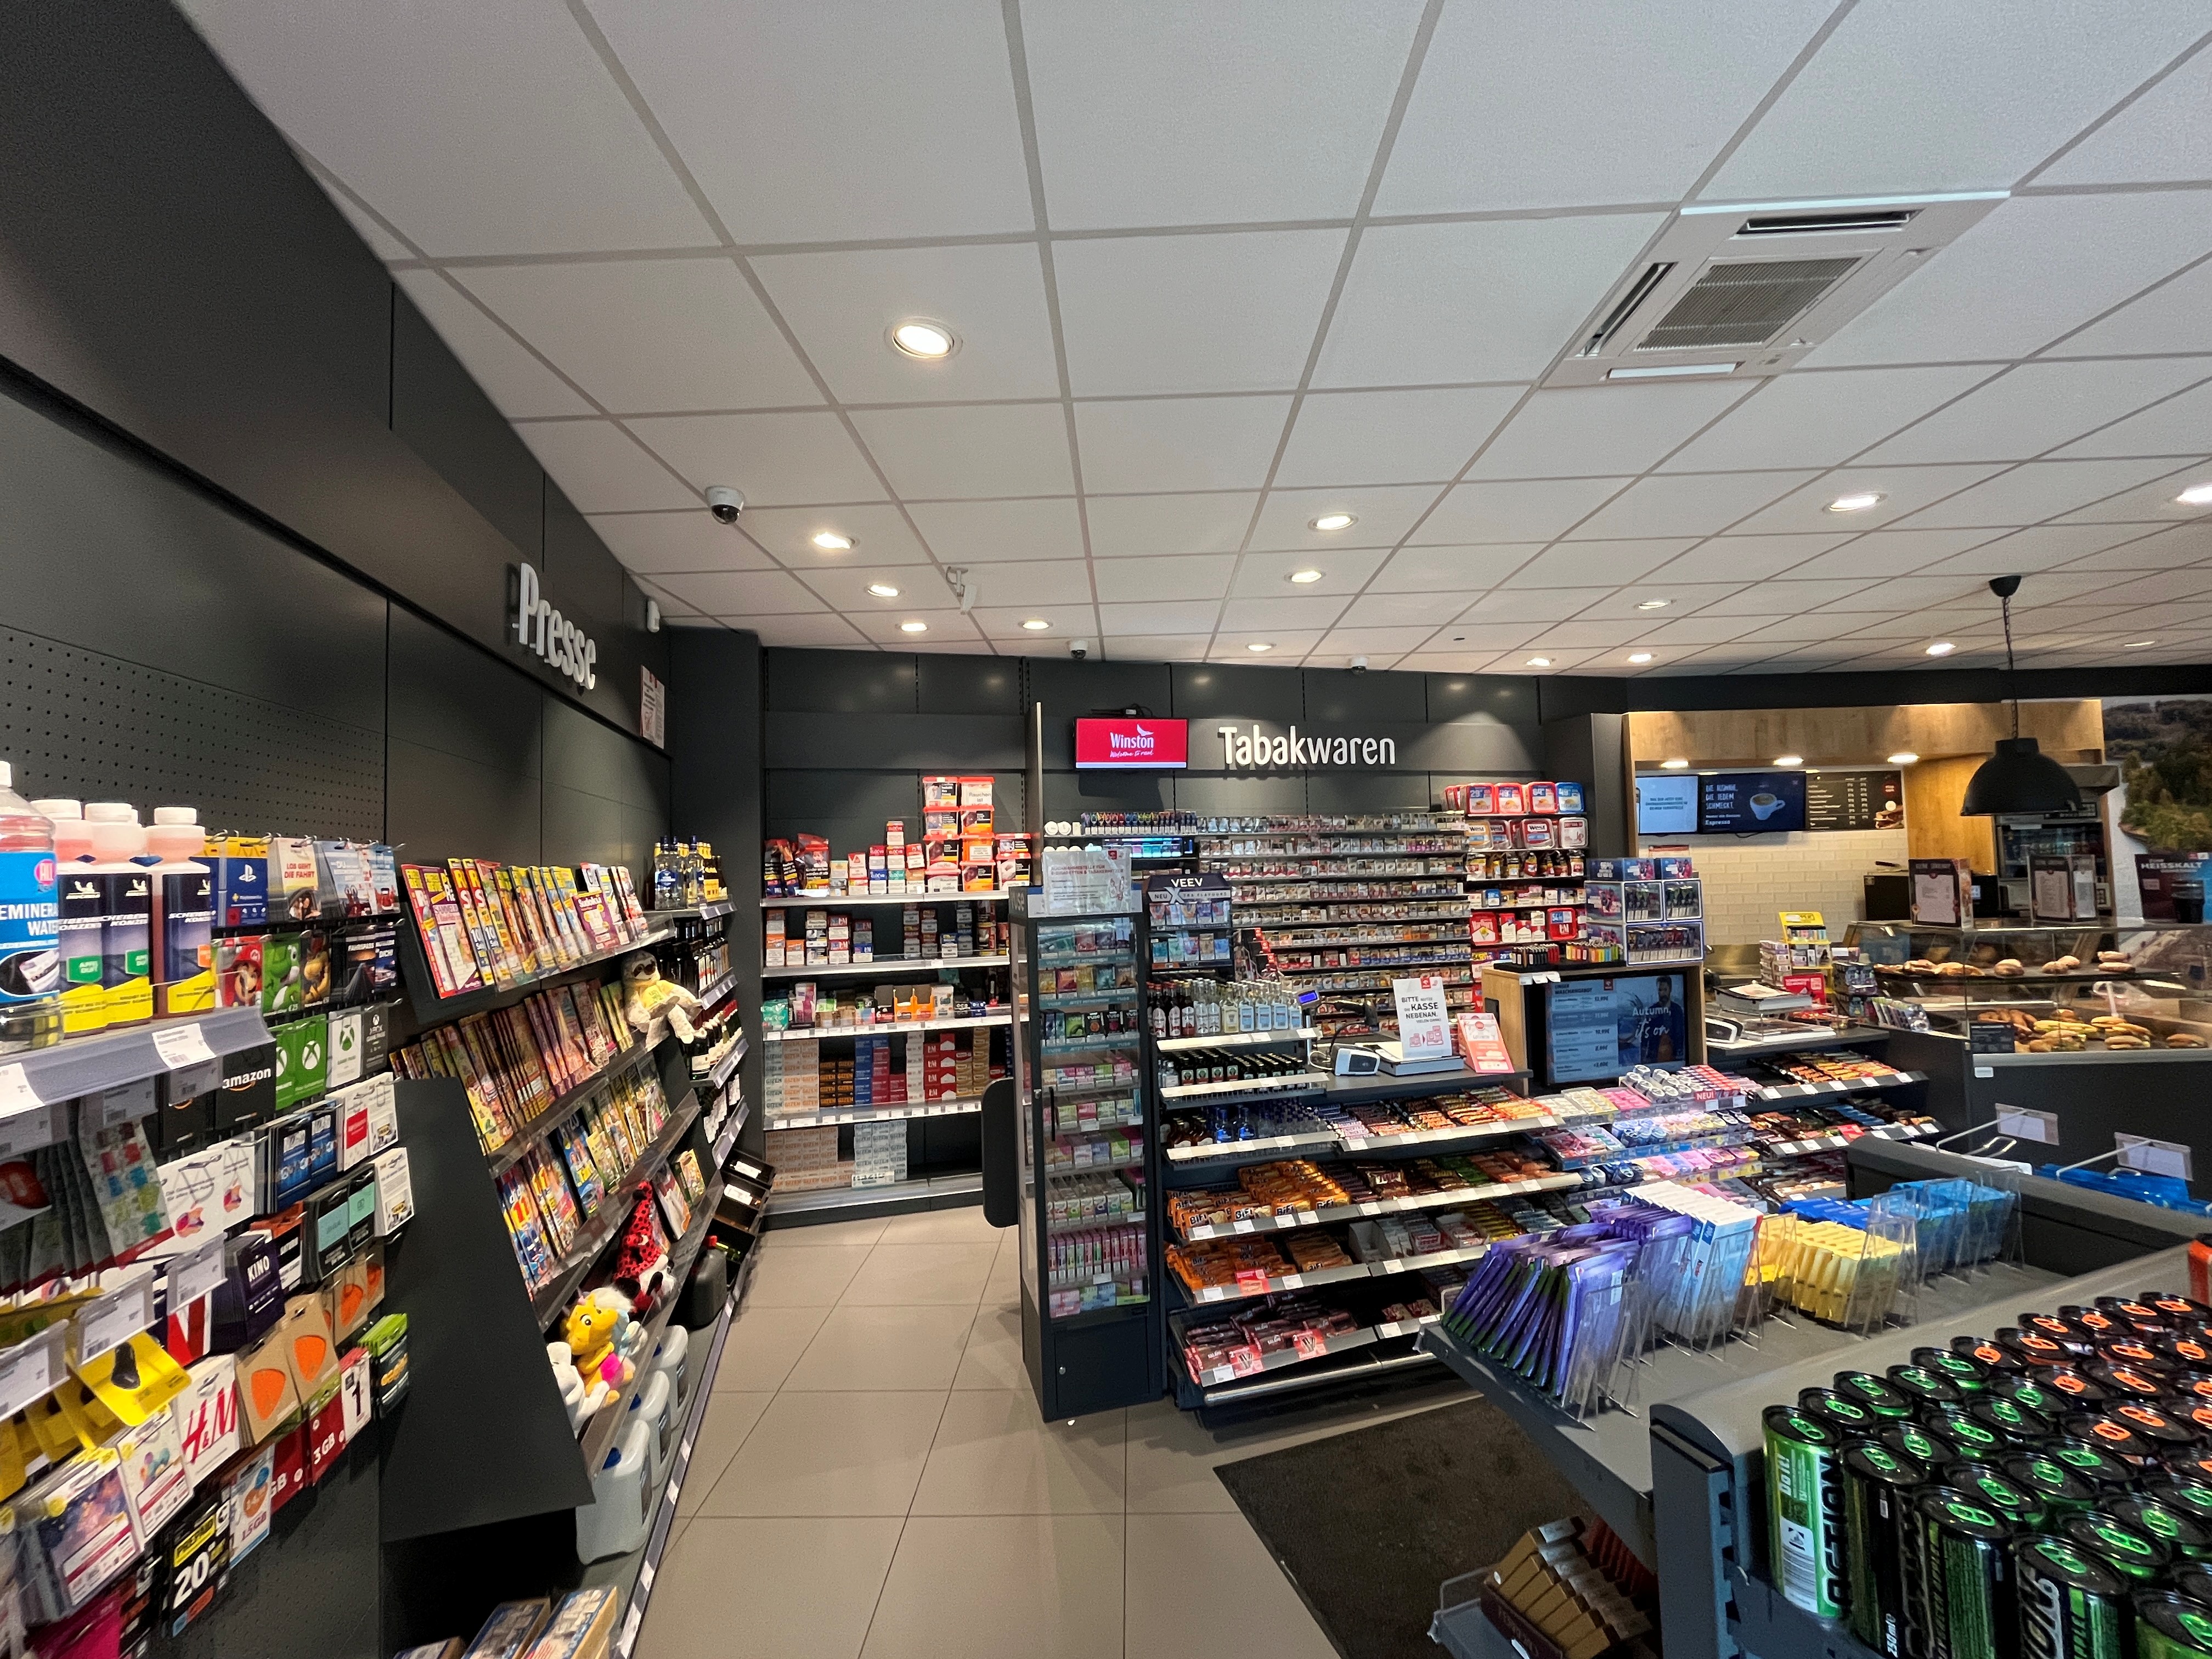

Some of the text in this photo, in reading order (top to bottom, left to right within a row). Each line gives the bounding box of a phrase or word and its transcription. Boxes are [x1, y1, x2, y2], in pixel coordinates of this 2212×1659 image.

[518, 562, 596, 690] Presse
[1110, 732, 1154, 748] Winston
[1219, 725, 1395, 765] Tabakwaren
[1171, 878, 1203, 887] VEEV
[578, 896, 602, 908] Sudoku
[1411, 1002, 1438, 1011] KASSE
[1633, 1006, 1671, 1017] Autumn,
[222, 1068, 272, 1090] amazon
[1697, 1091, 1714, 1100] NEU!
[1189, 1213, 1207, 1224] BiFi
[1235, 1209, 1252, 1220] BiFi
[247, 1255, 270, 1282] KINO
[182, 1380, 236, 1464] H&M
[314, 1431, 335, 1465] 3 GB
[173, 1551, 209, 1610] 20
